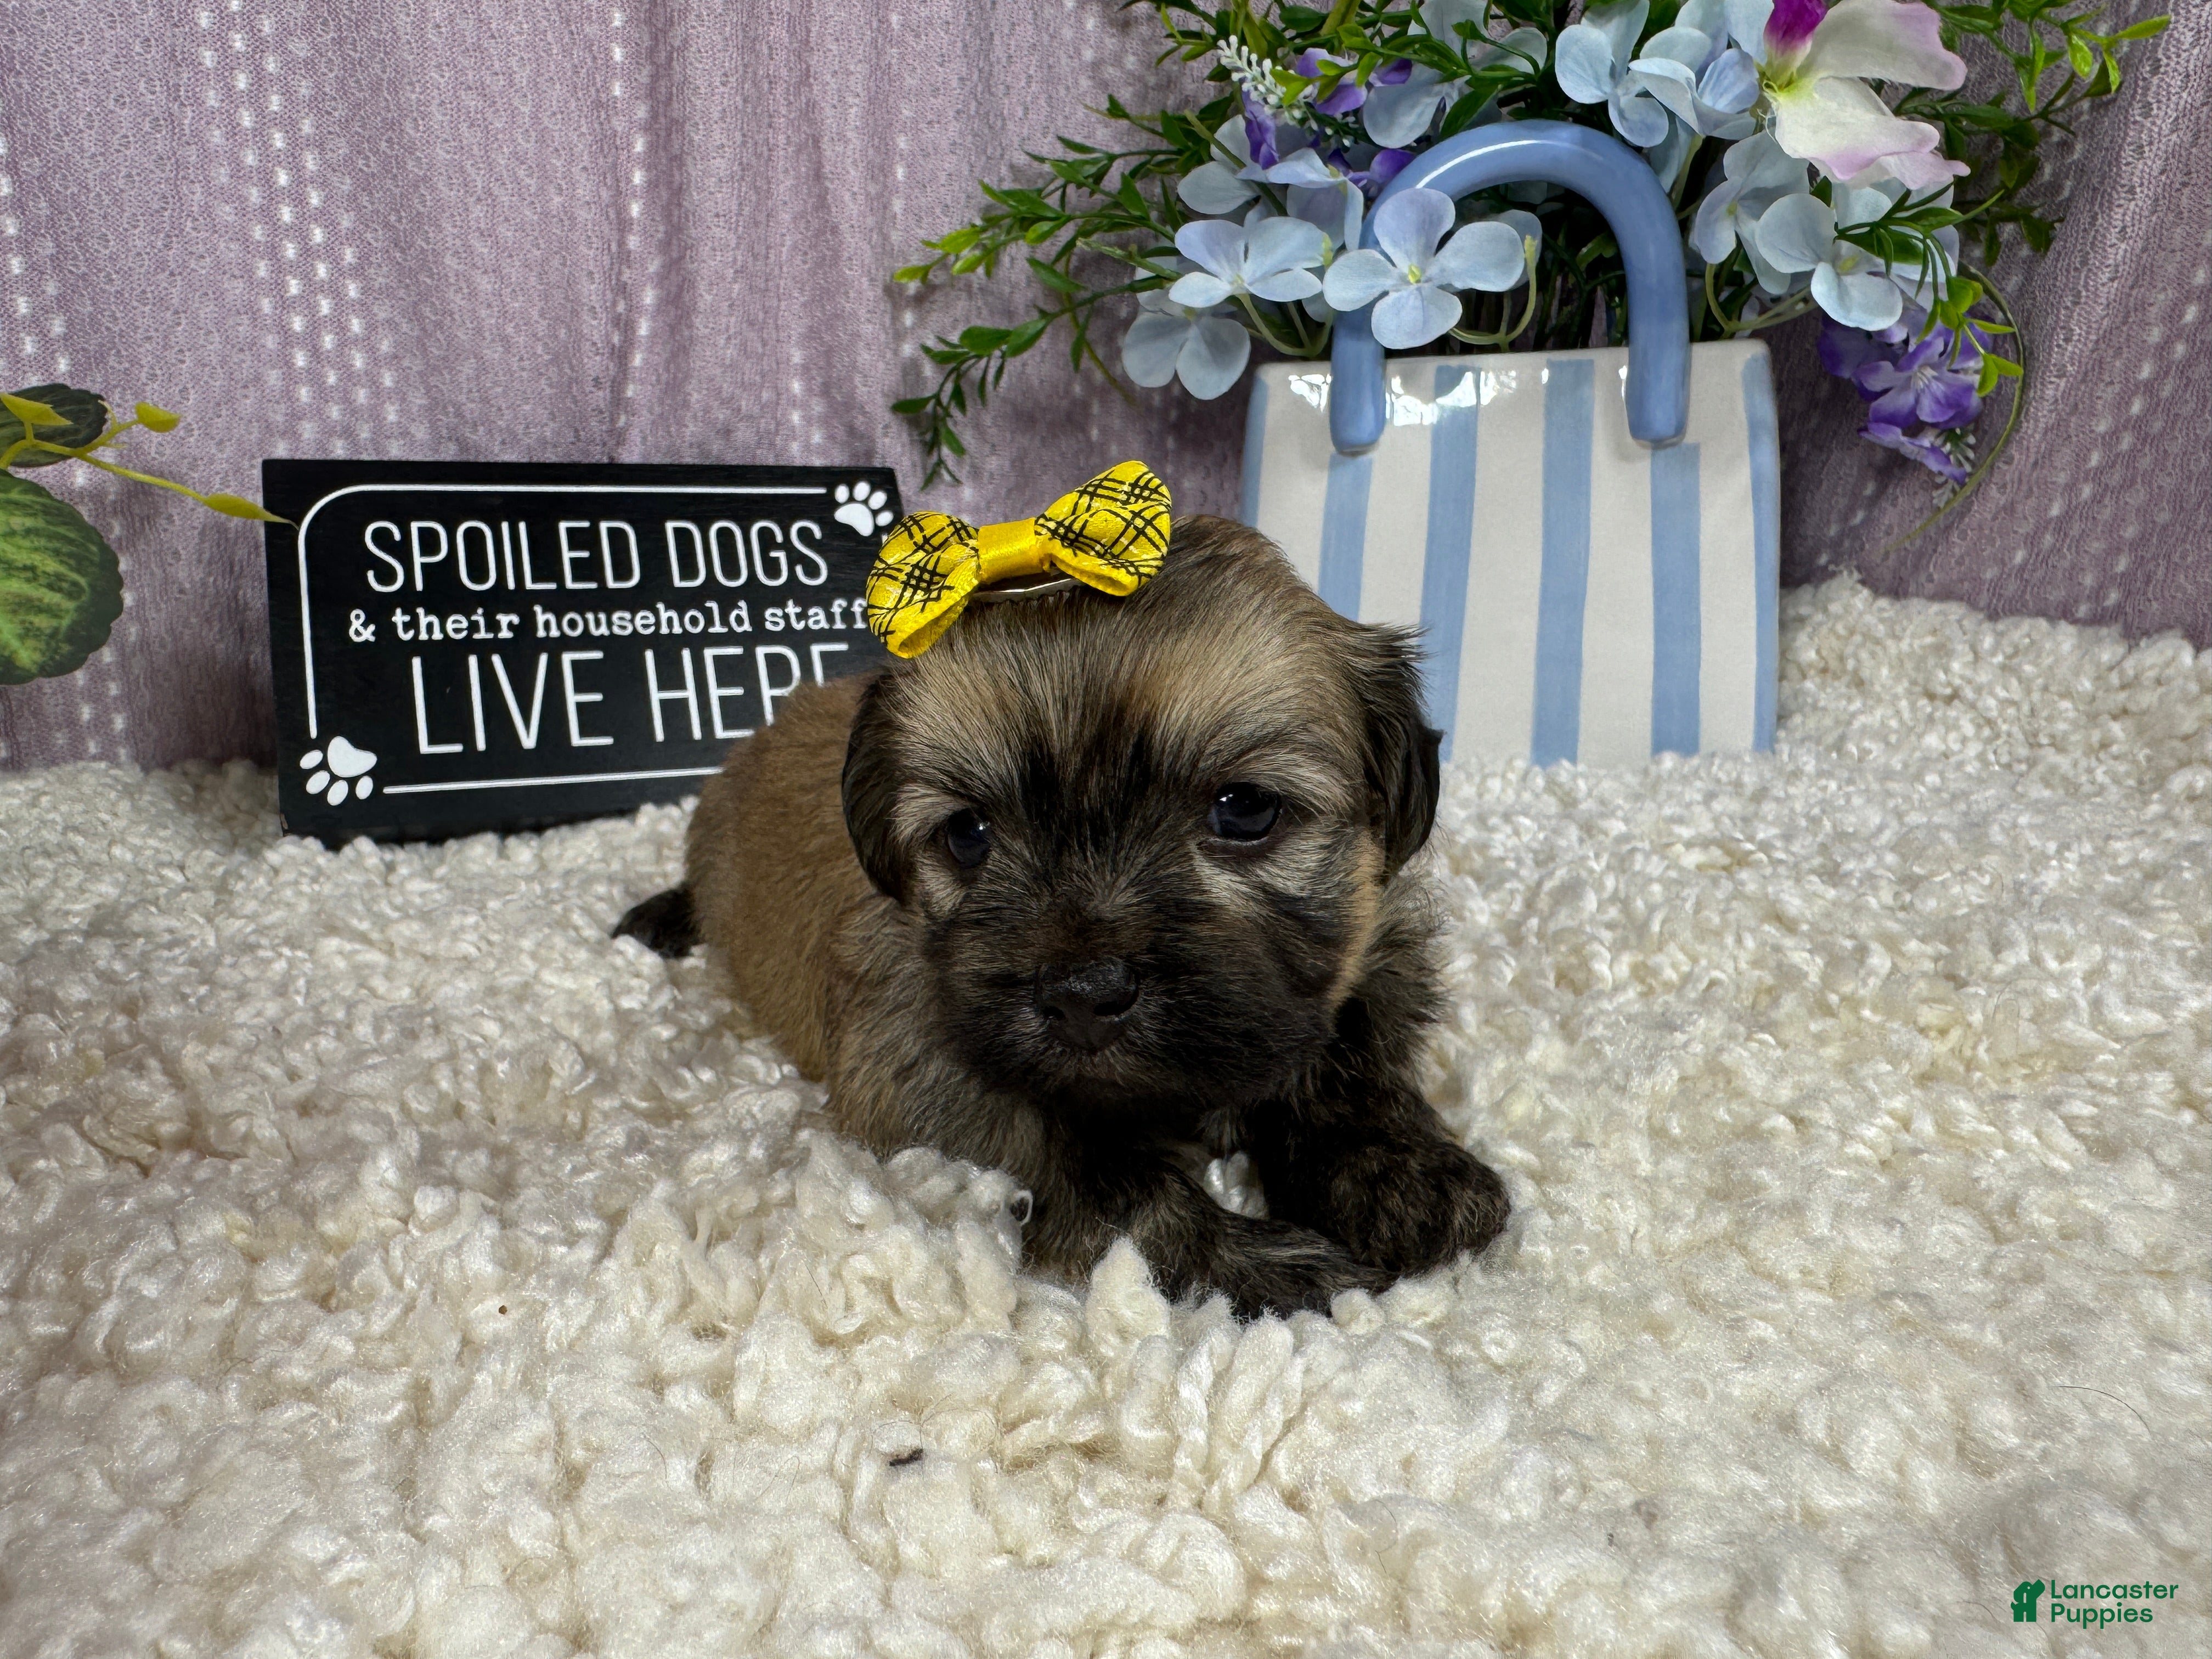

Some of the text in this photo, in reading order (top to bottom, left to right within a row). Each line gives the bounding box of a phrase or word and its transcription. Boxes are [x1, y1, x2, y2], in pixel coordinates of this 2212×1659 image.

[364, 520, 828, 592] SPOILED DOGS
[348, 597, 867, 642] & their household staff
[411, 650, 614, 754] LIVE
